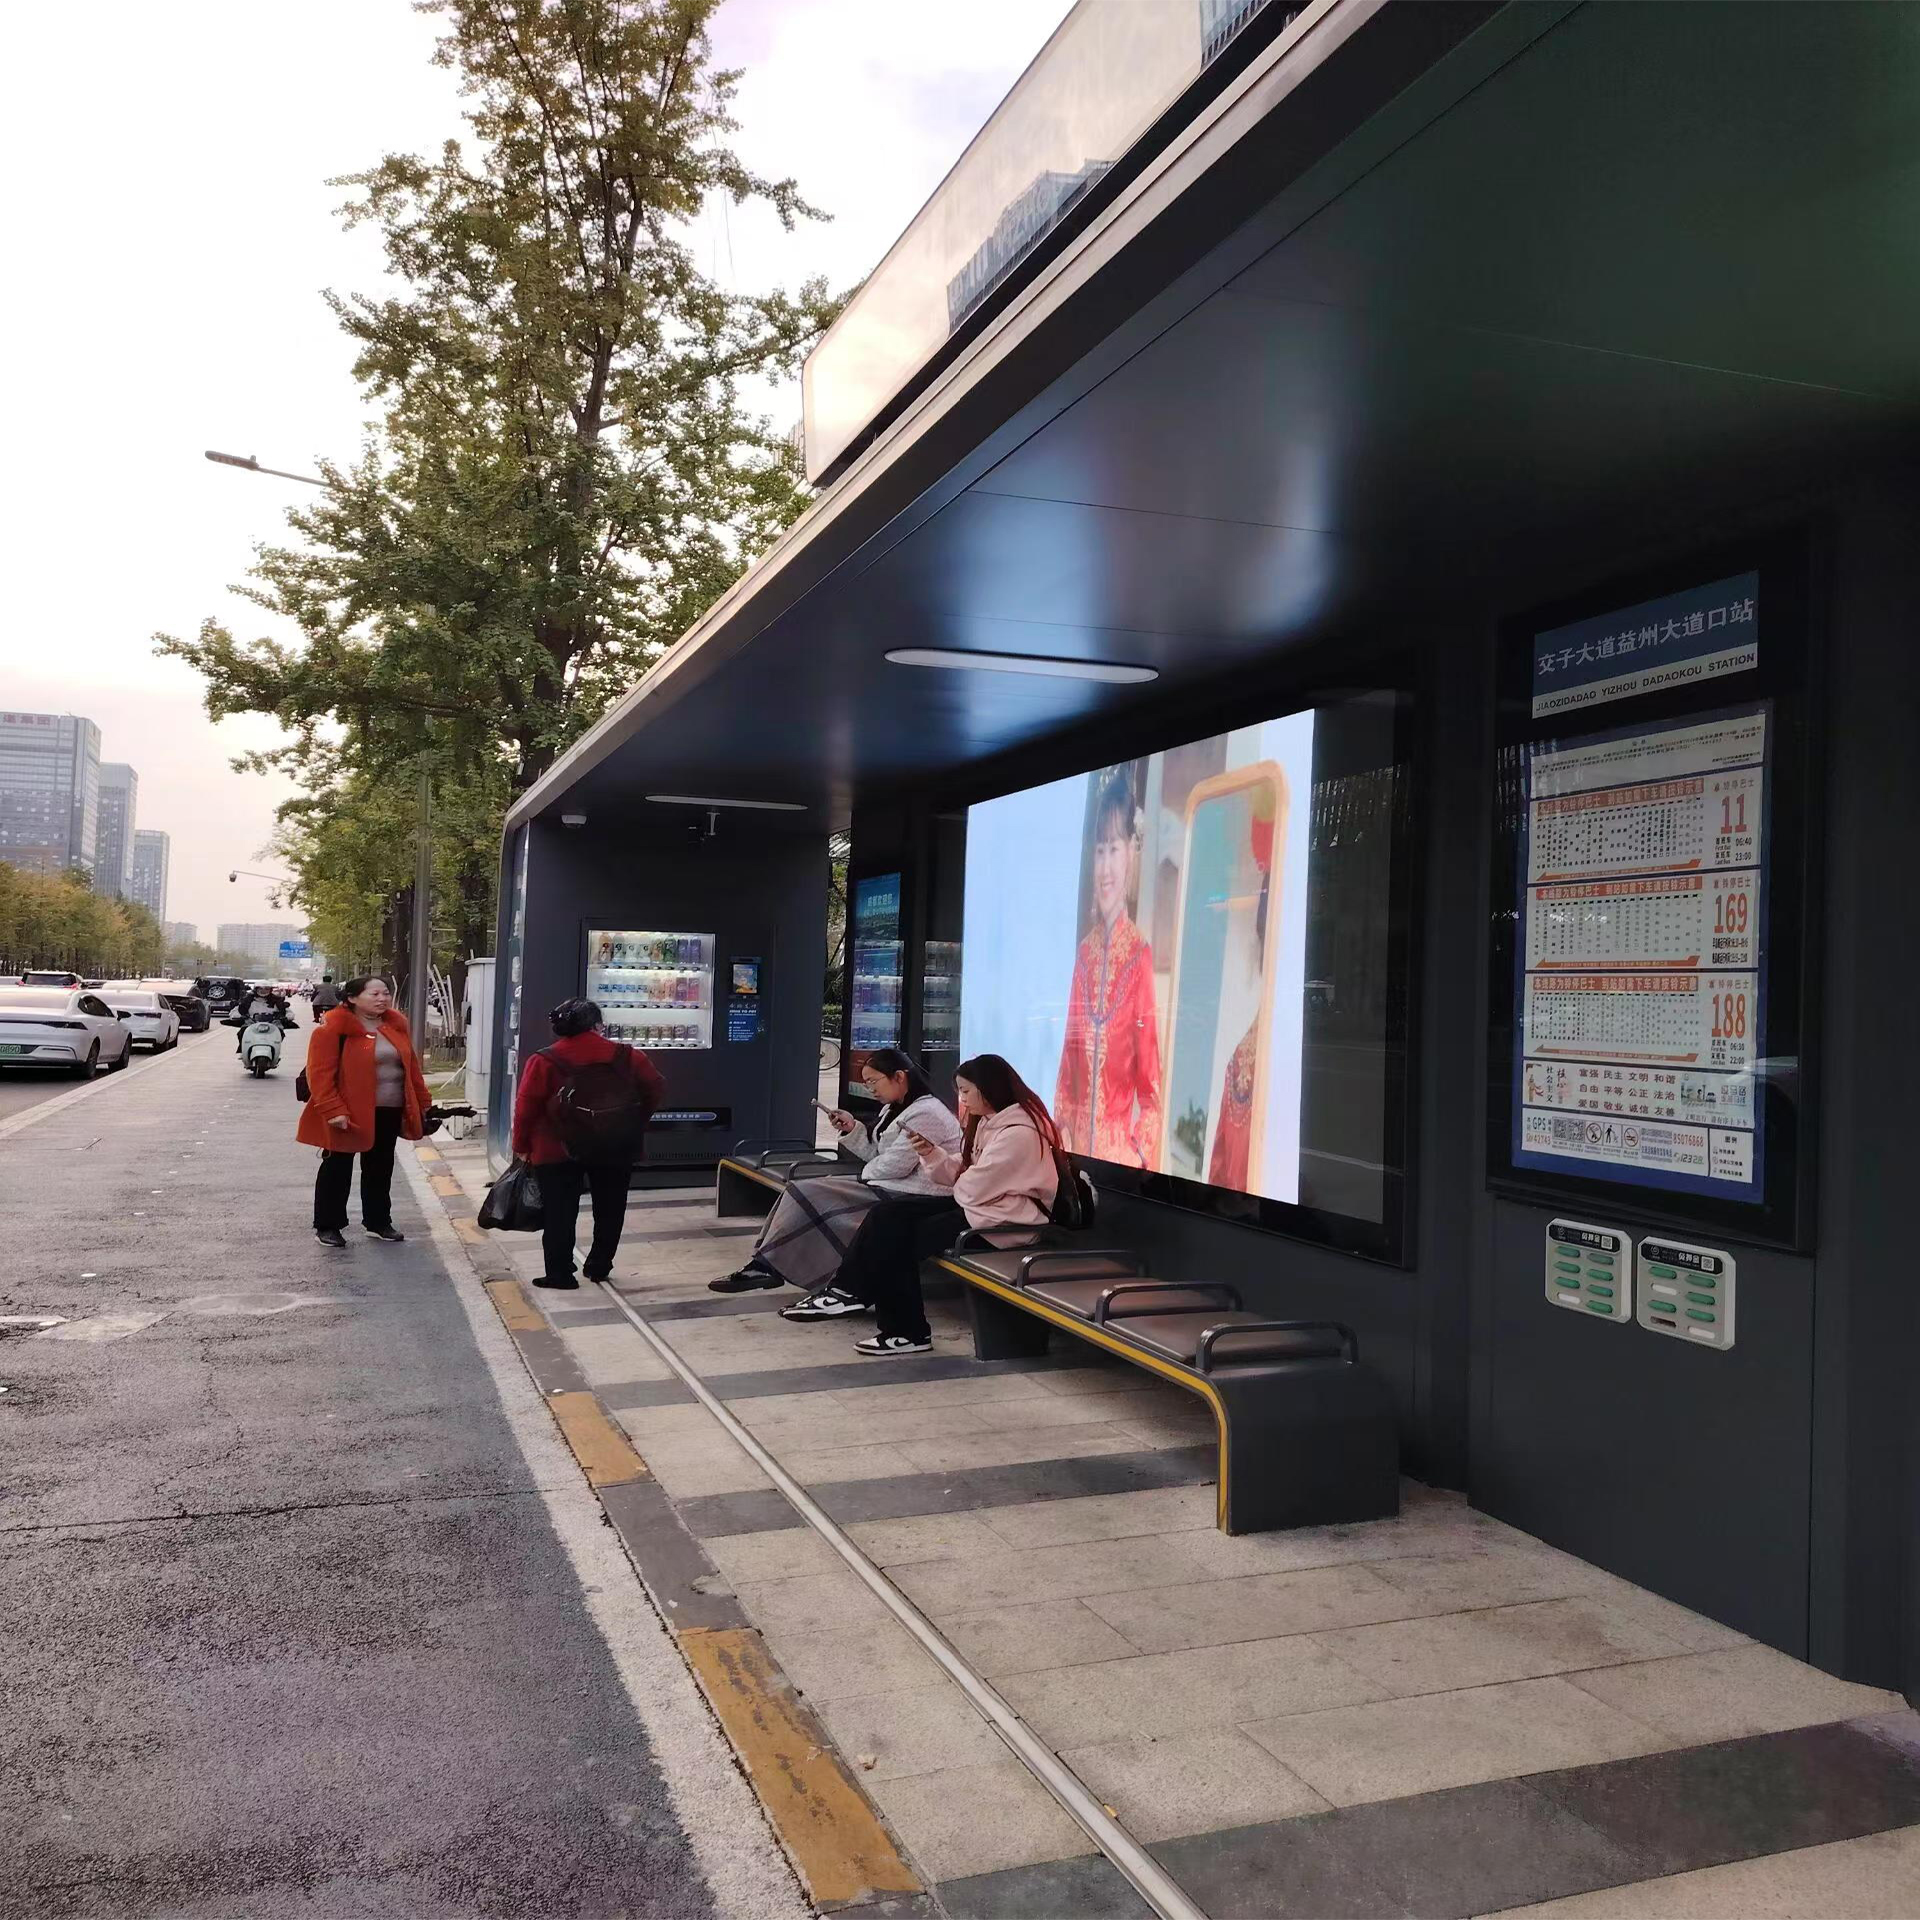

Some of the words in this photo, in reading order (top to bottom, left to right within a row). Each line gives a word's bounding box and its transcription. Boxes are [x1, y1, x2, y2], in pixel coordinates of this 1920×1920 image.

[1537, 597, 1755, 675] 交子大道益州大道口站
[1536, 690, 1597, 712] JIAOZIDADAO
[1601, 680, 1637, 697] YIZHOU
[1642, 665, 1702, 687] DADAOKOU
[1708, 652, 1755, 672] STATION
[1721, 793, 1747, 834] 11
[1714, 892, 1747, 933] 169
[1711, 993, 1746, 1039] 188
[1730, 1056, 1745, 1065] 22:00
[1579, 1068, 1599, 1079] 富强
[1603, 1070, 1623, 1080] 民主
[1628, 1072, 1649, 1082] 文明
[1653, 1073, 1676, 1084] 和谐
[1579, 1083, 1599, 1093] 自由
[1603, 1085, 1623, 1095] 平等
[1628, 1088, 1649, 1098] 公正
[1653, 1090, 1675, 1101] 法治
[1578, 1099, 1599, 1109] 爱国
[1603, 1101, 1624, 1111] 敬业
[1629, 1104, 1649, 1114] 诚信
[1654, 1106, 1675, 1117] 友善
[1532, 1116, 1546, 1131] GPS
[1680, 1153, 1704, 1165] 12328
